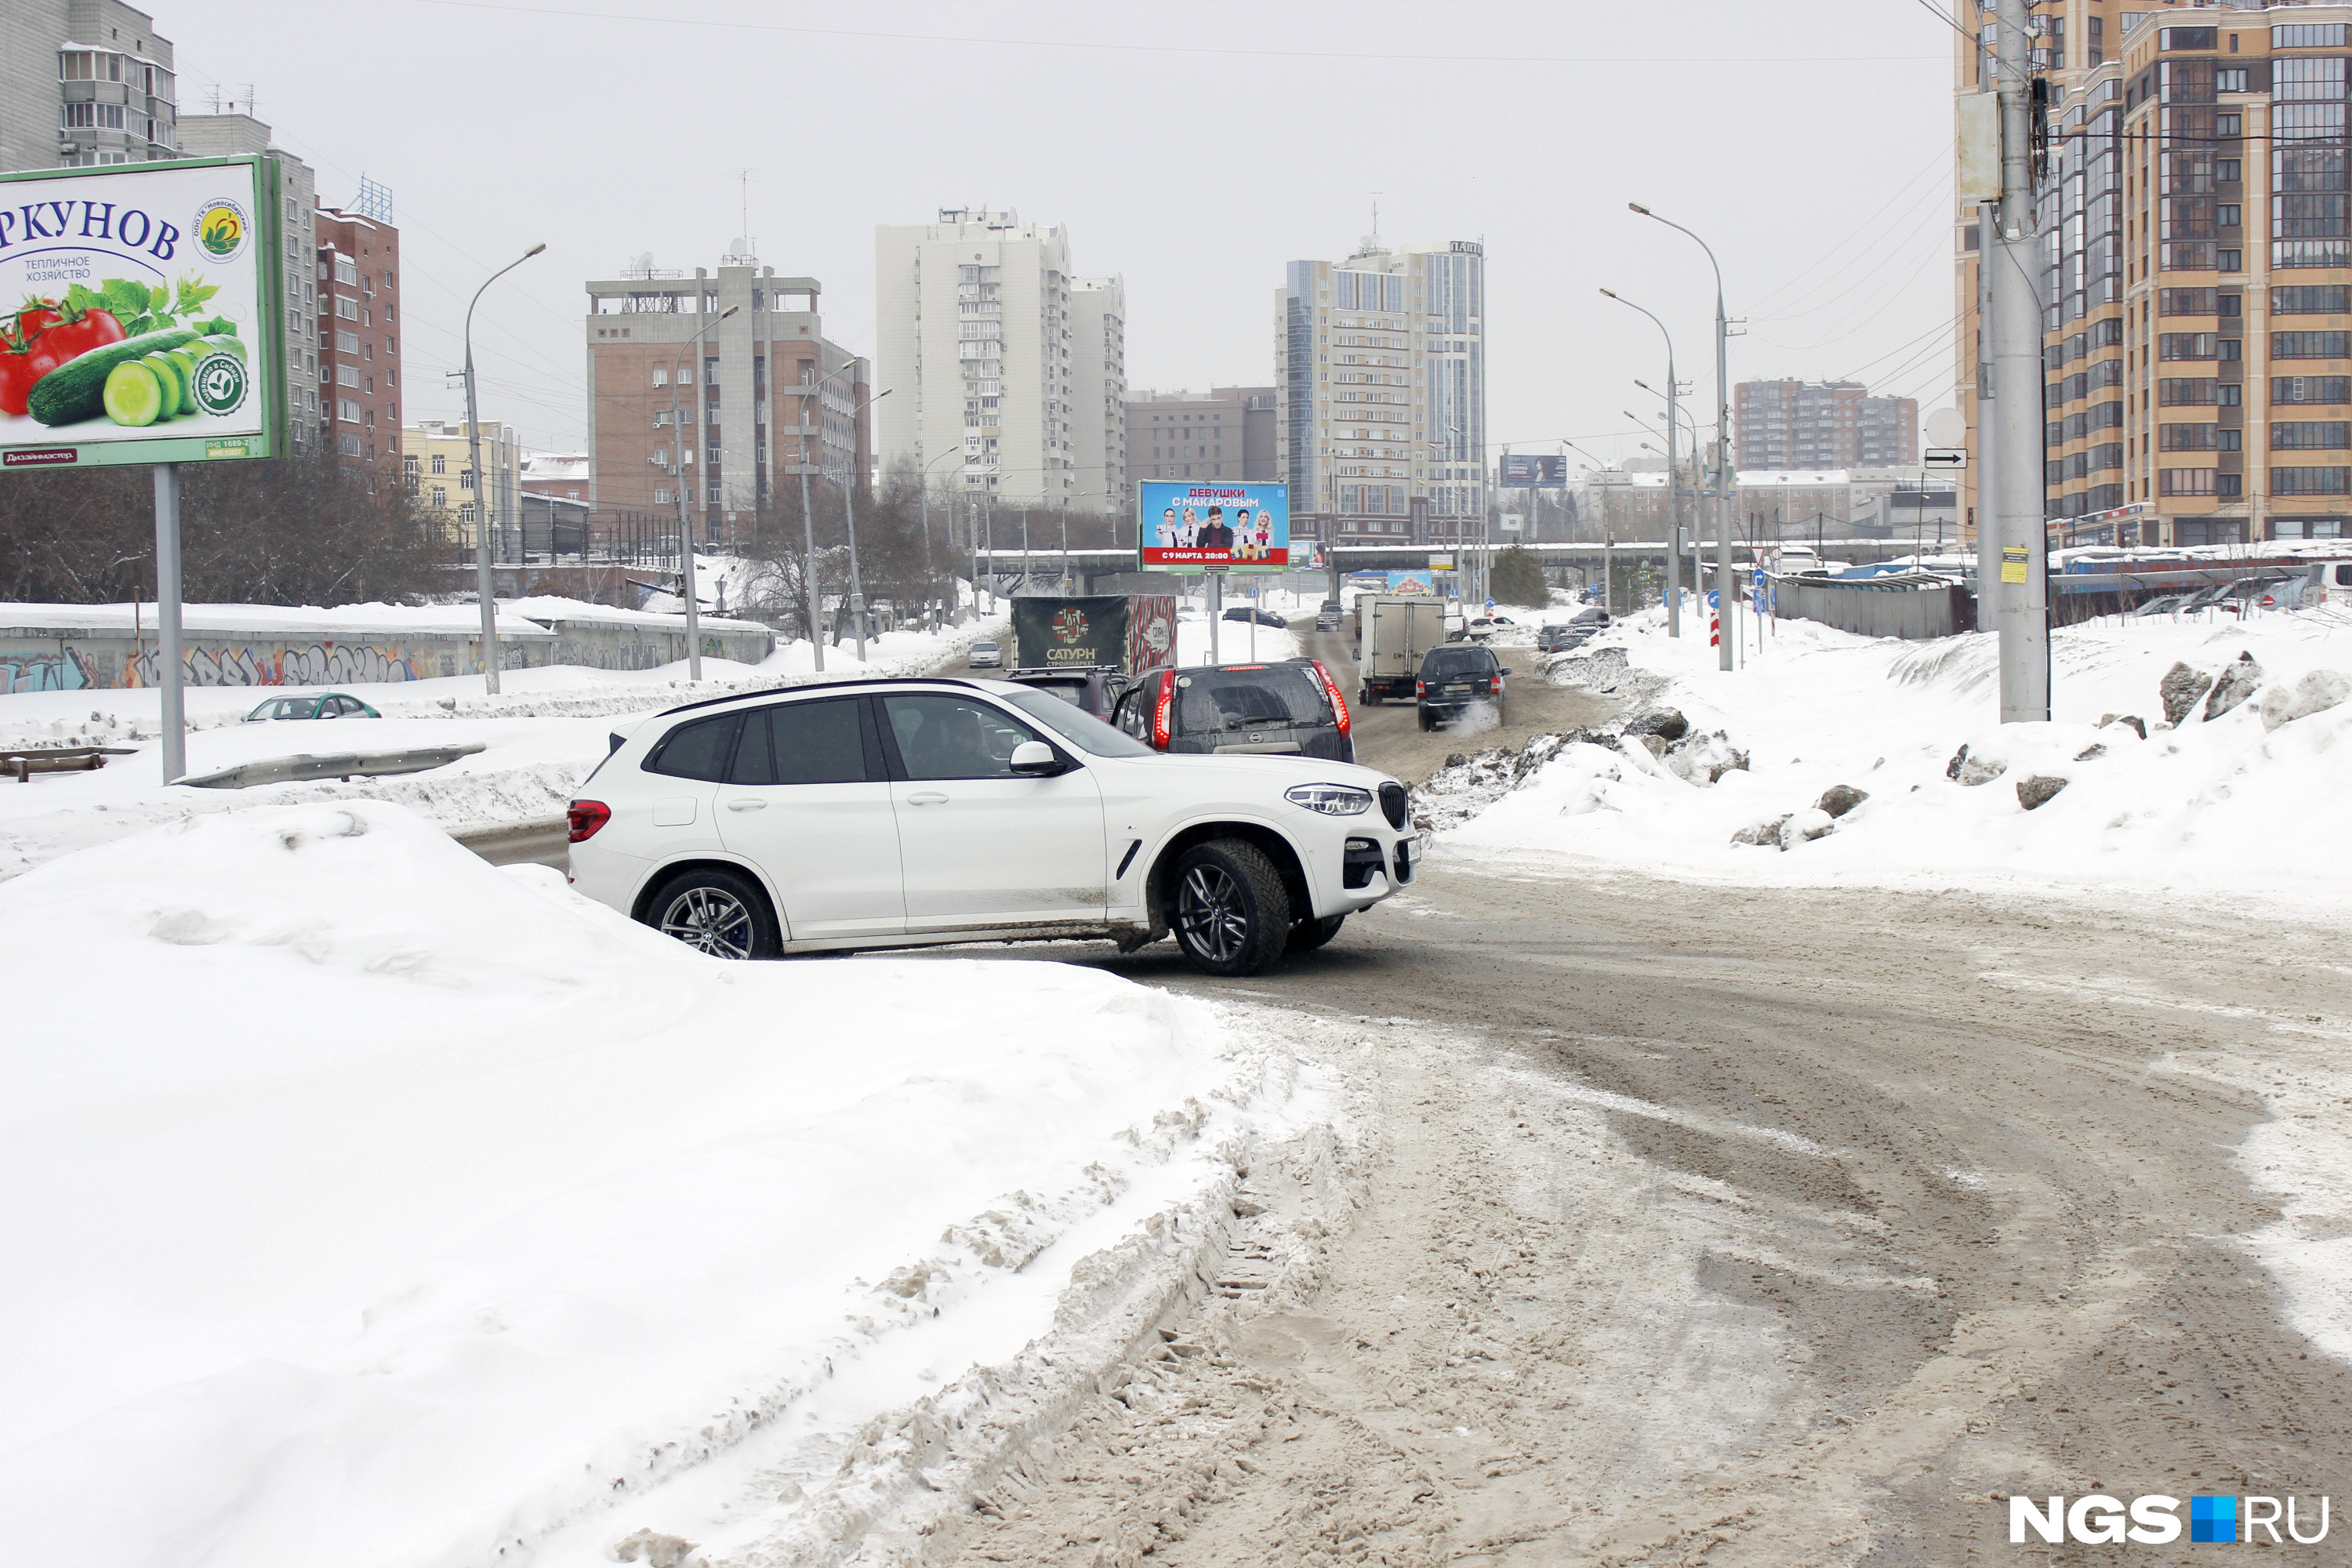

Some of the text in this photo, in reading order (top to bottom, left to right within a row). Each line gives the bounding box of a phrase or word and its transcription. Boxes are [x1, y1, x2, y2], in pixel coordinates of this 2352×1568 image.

[198, 209, 206, 218] ТК
[25, 256, 90, 269] ТЕПЛИЧНОЕ
[26, 268, 90, 281] ХОЗЯЙСТВО
[220, 361, 240, 383] Сибири
[1189, 488, 1245, 498] ДЕВУШКИ
[1172, 497, 1260, 508] С МАКАРОВЫМ
[1230, 543, 1270, 561] ТНТ
[1047, 648, 1095, 660] САТУРН
